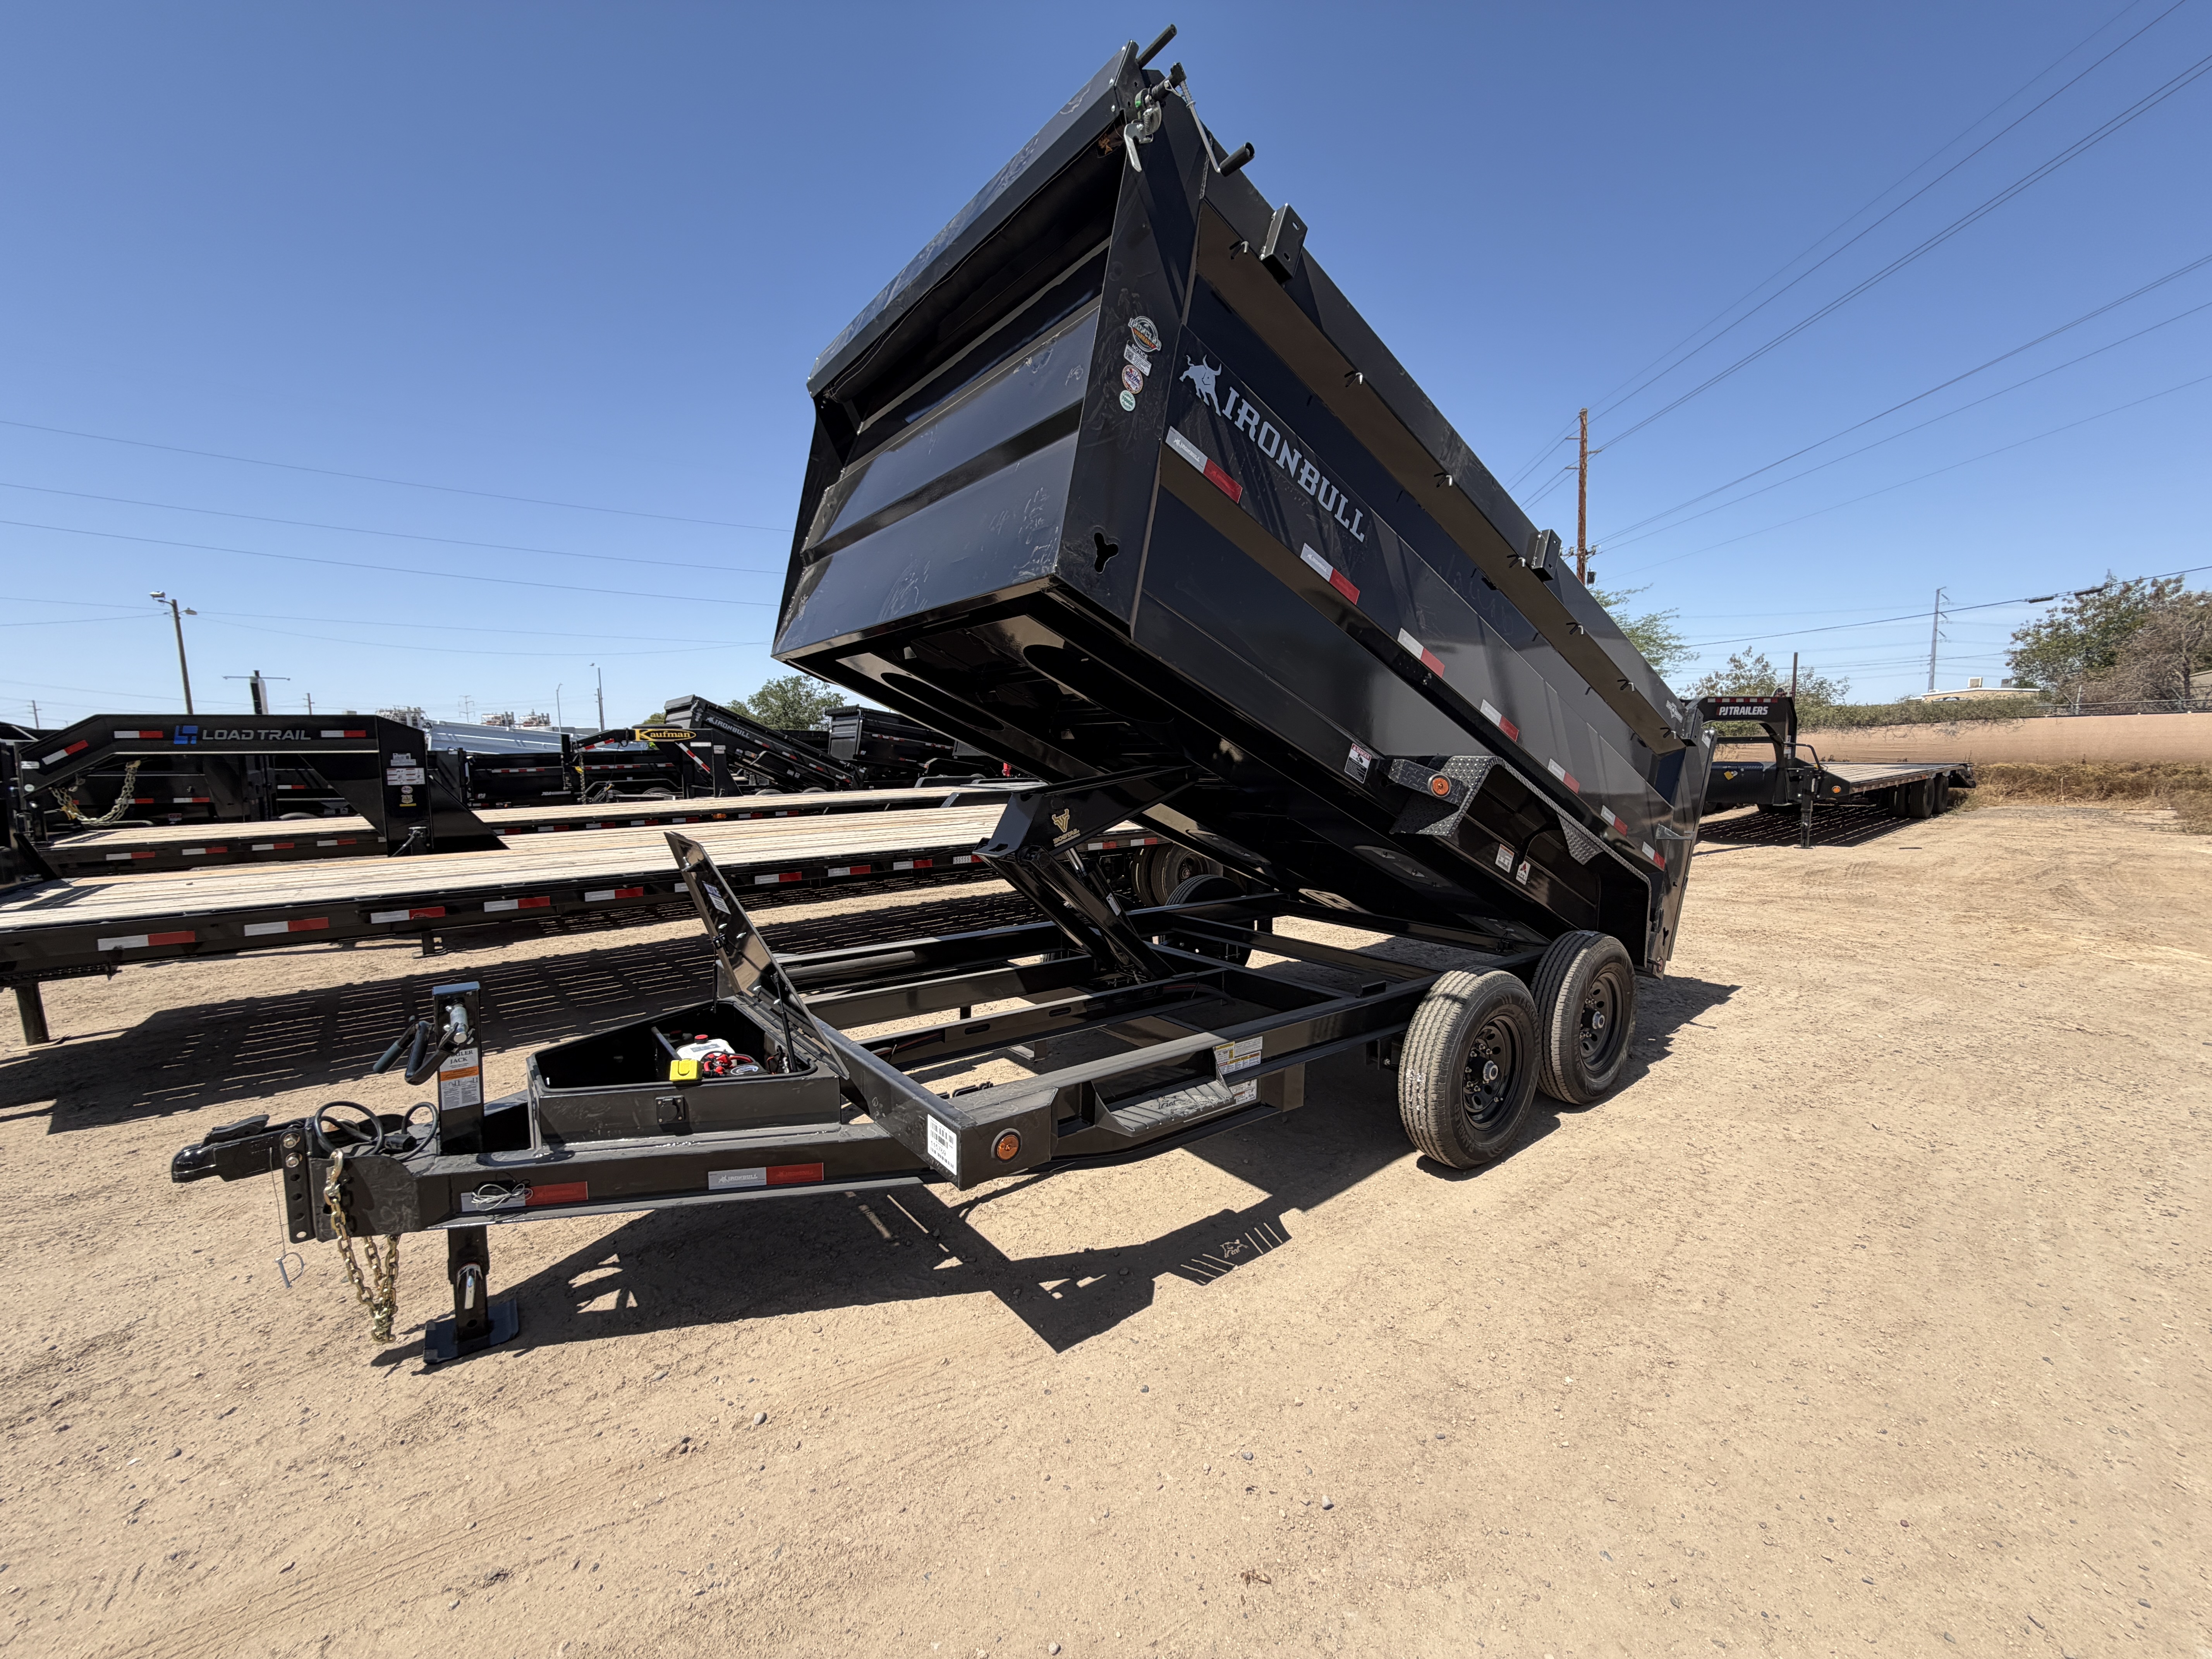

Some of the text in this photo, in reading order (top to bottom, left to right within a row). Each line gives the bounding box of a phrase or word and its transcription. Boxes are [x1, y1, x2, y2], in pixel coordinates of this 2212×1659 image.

[1132, 343, 1148, 361] NOTICE
[1222, 386, 1365, 543] IRONBULL
[1719, 706, 1769, 716] PJ TRAILERS
[203, 730, 311, 740] LOAD TRAIL
[635, 729, 691, 741] Kaufman
[715, 718, 750, 739] IRONBULL
[1356, 747, 1370, 760] DANGER
[1454, 1103, 1475, 1153] RAMBLER
